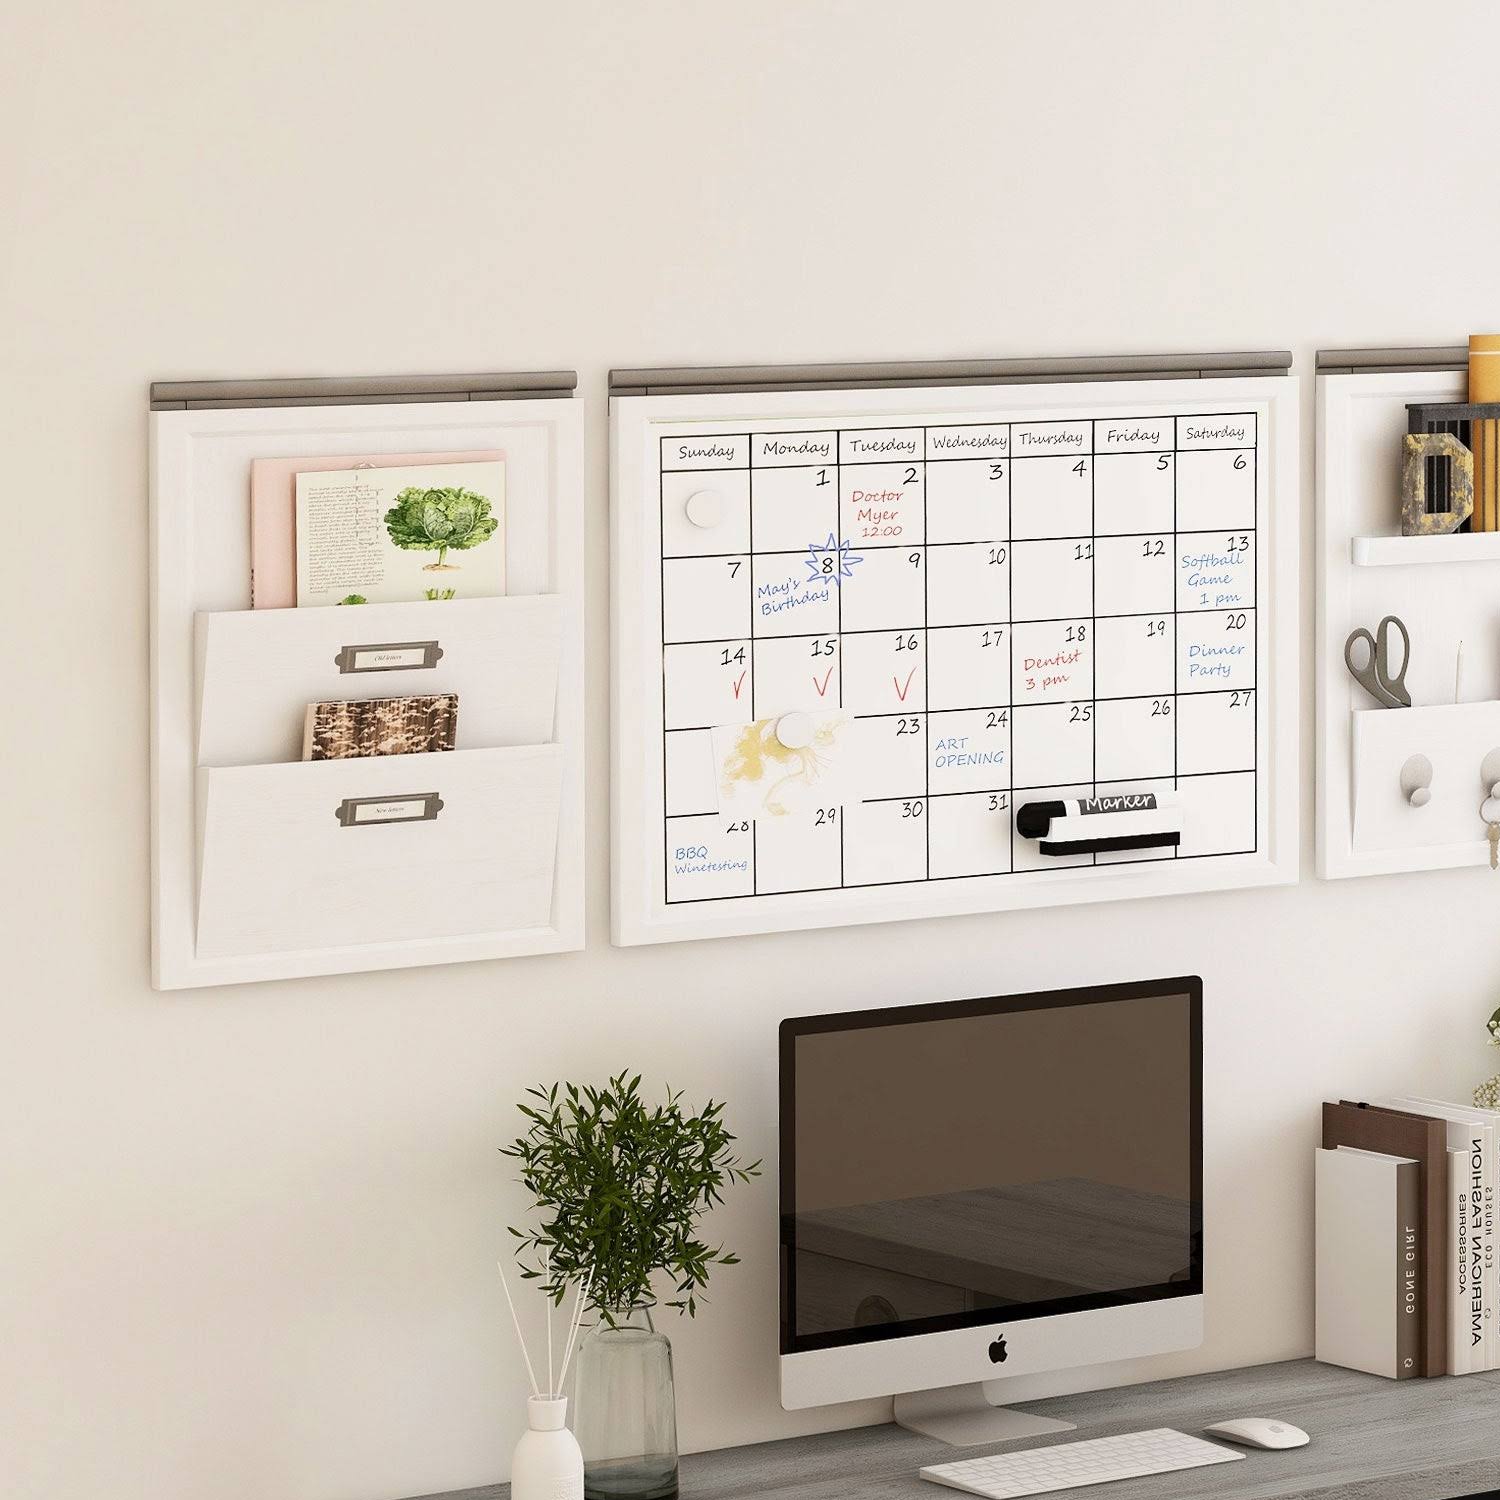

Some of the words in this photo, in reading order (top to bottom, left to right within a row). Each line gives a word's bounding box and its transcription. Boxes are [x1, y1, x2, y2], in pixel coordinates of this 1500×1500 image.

[679, 446, 735, 460] Sunday
[763, 441, 831, 457] Monday
[850, 438, 917, 454] Tuesday
[933, 435, 1008, 451] Wednesday
[1020, 432, 1084, 447] Thursday
[1107, 428, 1160, 443] Friday
[1186, 425, 1246, 441] Saturday
[816, 470, 830, 486] 1
[903, 468, 919, 485] 2
[989, 465, 1003, 480] 3
[1072, 460, 1087, 477] 4
[1156, 455, 1172, 471] 5
[1233, 455, 1246, 470] 6
[852, 490, 904, 502] Doctor
[857, 509, 898, 522] Myer
[862, 526, 903, 538] 12:00
[727, 562, 741, 578] 7
[822, 558, 833, 574] 8
[909, 553, 921, 568] 9
[989, 549, 1006, 565] 10
[1075, 544, 1094, 560] 11
[1143, 541, 1166, 557] 12
[1227, 536, 1250, 552] 13
[1182, 553, 1244, 569] Softball
[758, 578, 801, 598] May's
[1188, 573, 1233, 586] Game
[761, 588, 829, 616] Birthday
[1216, 595, 1242, 607] pm
[721, 647, 746, 665] 14
[811, 640, 837, 657] 15
[895, 634, 918, 652] 16
[981, 631, 1003, 647] 17
[1065, 626, 1086, 642] 18
[1147, 620, 1166, 637] 19
[1226, 614, 1246, 631] 20
[1189, 644, 1246, 658] Dinner
[1024, 649, 1083, 672] Dentist
[1190, 663, 1232, 678] Party
[1025, 677, 1036, 691] 3
[1043, 674, 1071, 690] pm
[897, 718, 920, 736] 23
[986, 711, 1008, 729] 24
[1070, 705, 1093, 722] 25
[1152, 700, 1171, 717] 26
[1229, 691, 1251, 708] 27
[936, 737, 969, 750] ART
[935, 751, 1004, 768] OPENING
[815, 809, 836, 826] 29
[902, 801, 923, 818] 30
[989, 795, 1009, 811] 31
[1086, 794, 1152, 812] Marker
[675, 846, 709, 861] BBQ
[674, 859, 748, 875] Winetesting
